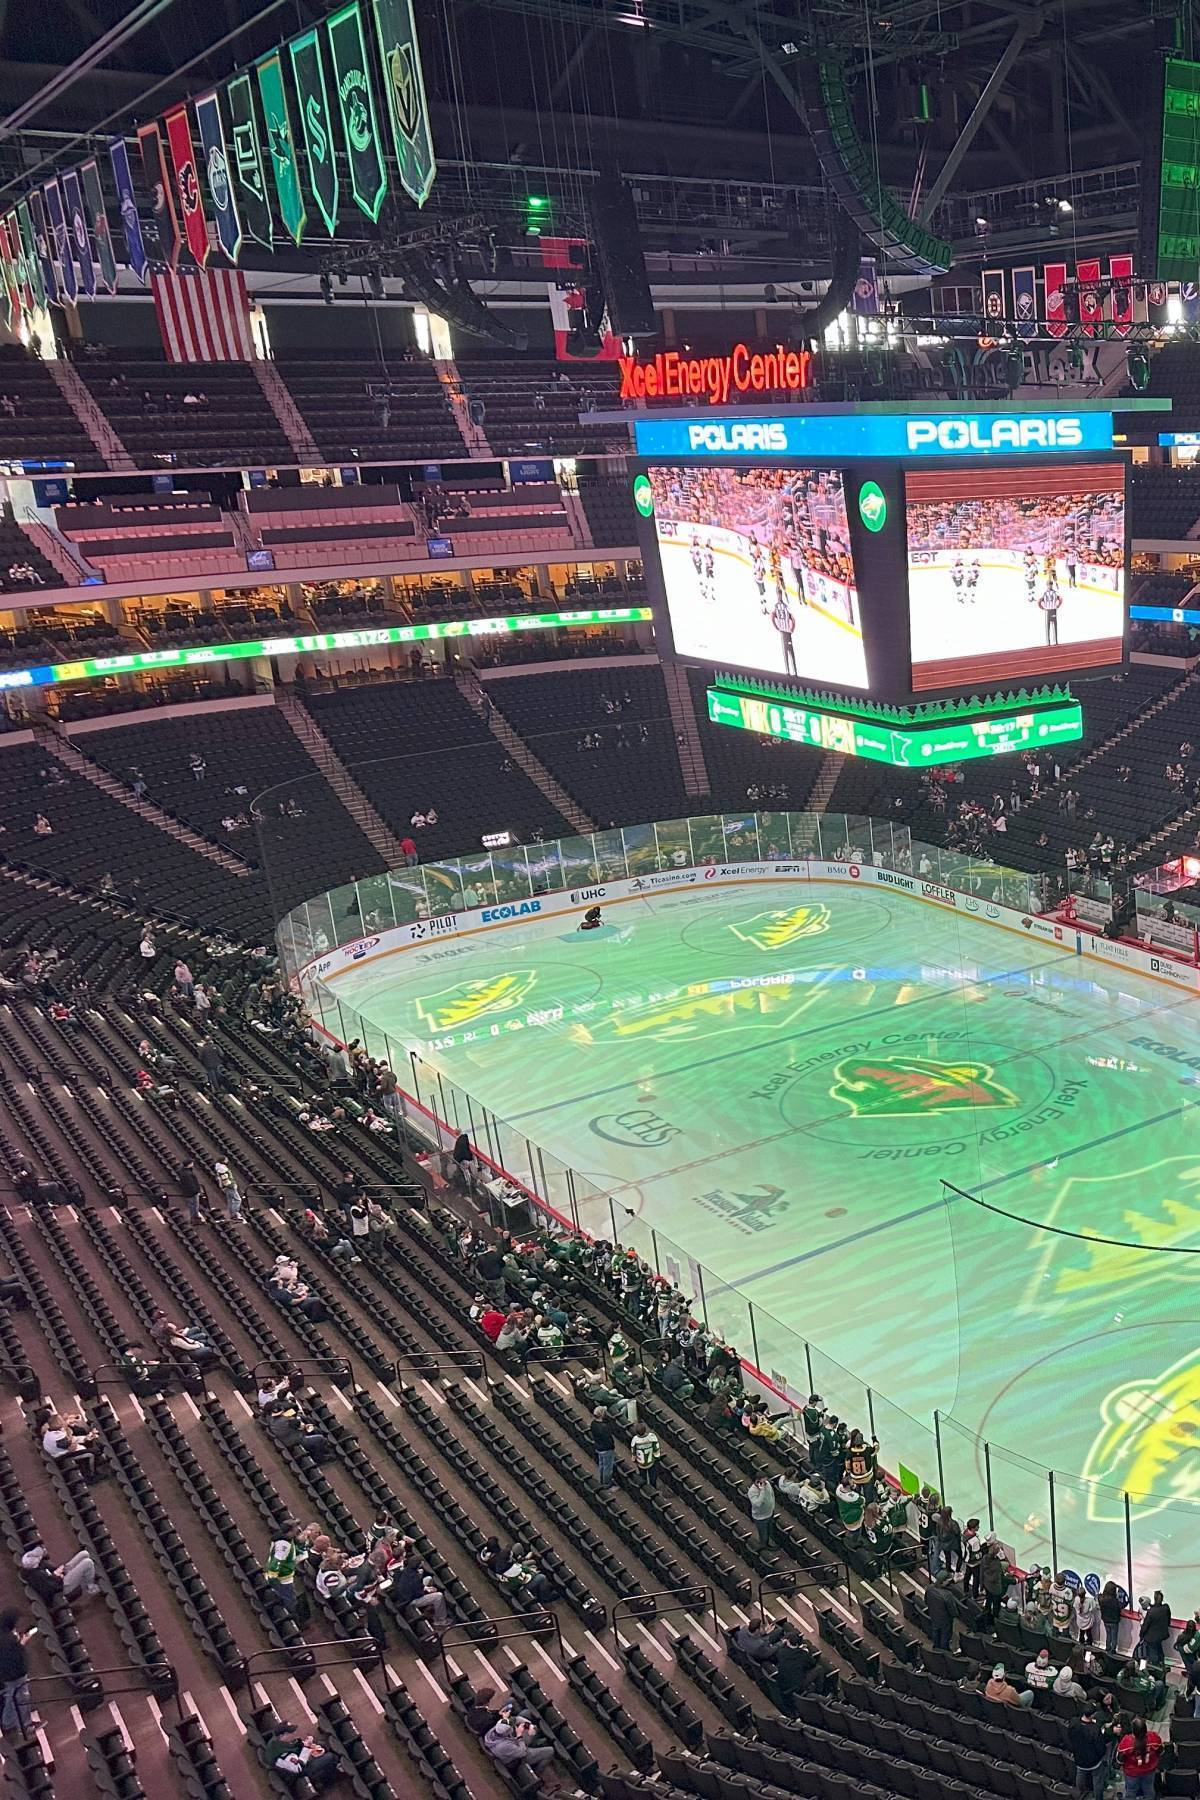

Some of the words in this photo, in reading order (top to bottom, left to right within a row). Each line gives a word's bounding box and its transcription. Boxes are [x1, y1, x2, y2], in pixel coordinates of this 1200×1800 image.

[619, 353, 664, 398] Xcel
[665, 352, 731, 404] Energy
[733, 343, 811, 392] Center
[689, 423, 788, 451] POLARIS
[906, 418, 1083, 450] POLARIS
[659, 521, 679, 537] EQT
[910, 551, 938, 566] EQT
[720, 867, 740, 875] Xcel
[740, 866, 768, 874] Energy
[827, 866, 847, 874] BMO
[877, 871, 893, 884] BUD
[893, 876, 914, 890] LIGHT
[581, 887, 606, 901] UHC
[921, 881, 955, 901] LOFFLER
[481, 900, 542, 923] ECOLAB
[429, 915, 457, 931] PILOT
[344, 941, 374, 956] HOCKEY
[750, 1071, 793, 1102] Xcel
[793, 1037, 872, 1073] Energy
[881, 1027, 974, 1045] Center
[1055, 1079, 1089, 1108] Xcel
[615, 1110, 683, 1143] CHS
[978, 1107, 1066, 1148] Energy
[856, 1141, 967, 1161] Center
[702, 1188, 741, 1214] Treasure
[738, 1206, 776, 1232] Island
